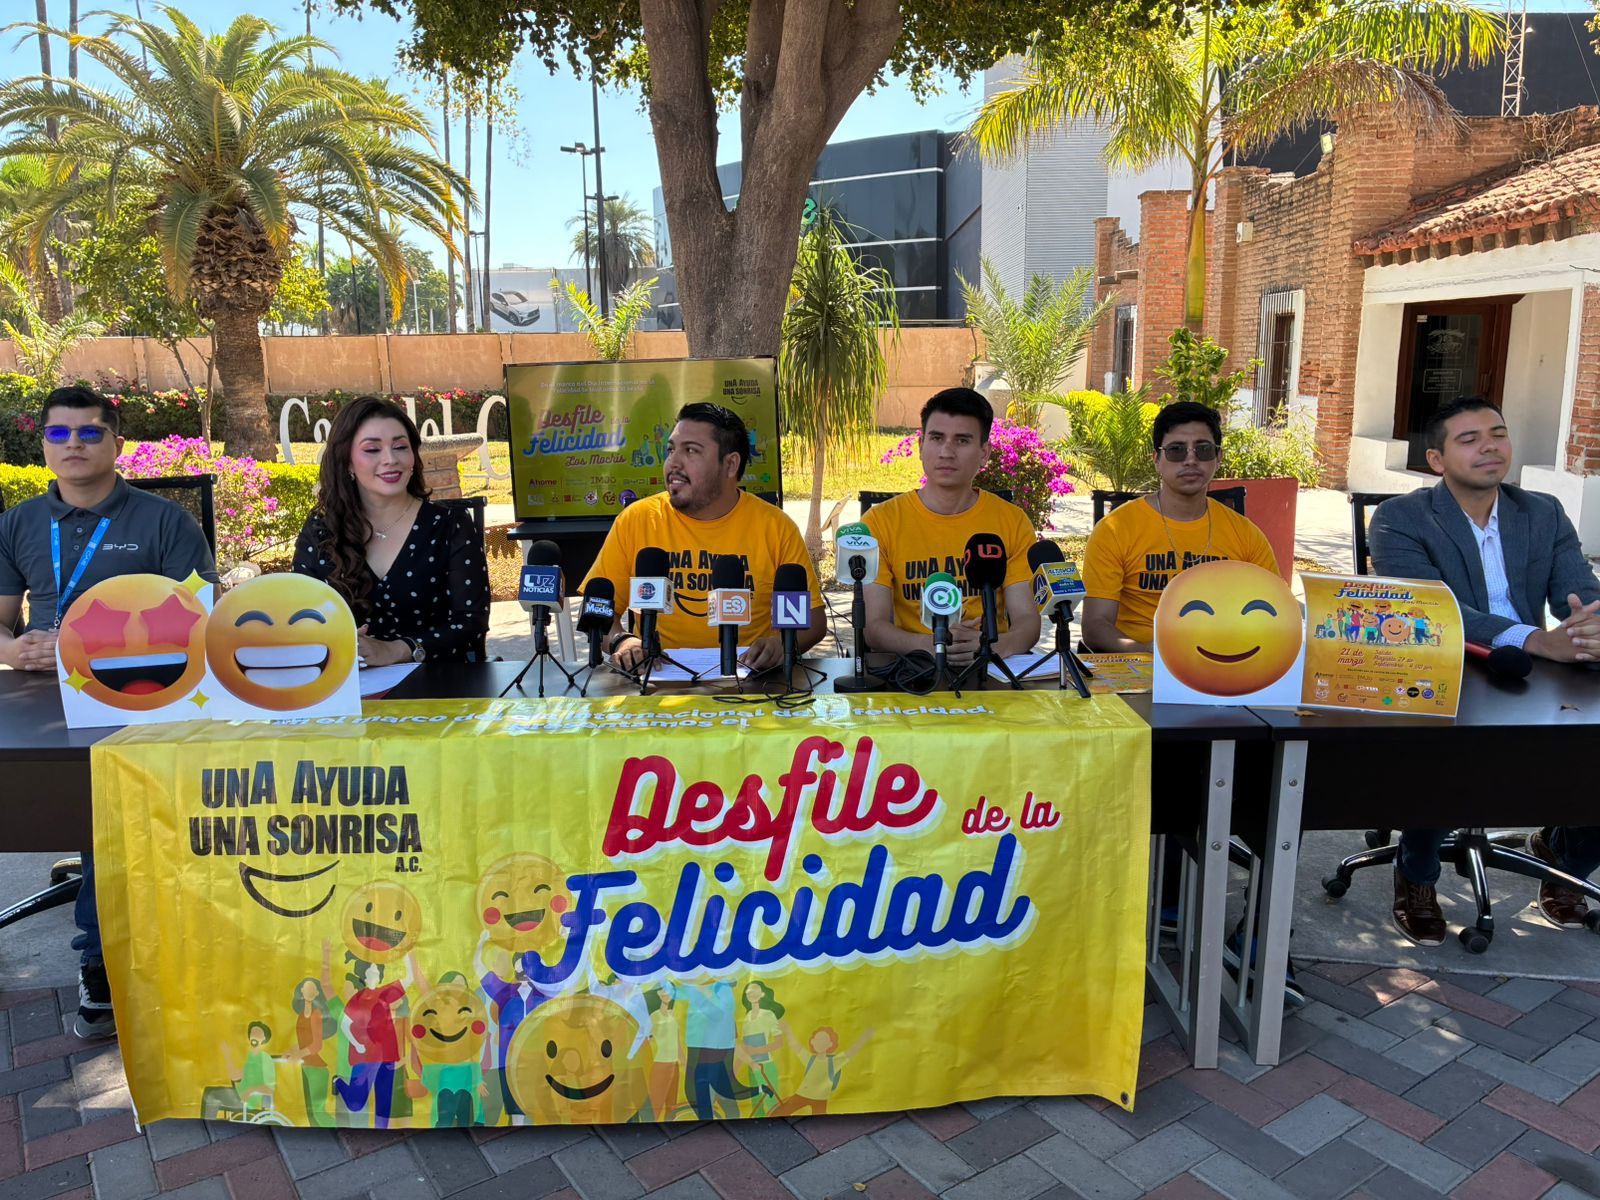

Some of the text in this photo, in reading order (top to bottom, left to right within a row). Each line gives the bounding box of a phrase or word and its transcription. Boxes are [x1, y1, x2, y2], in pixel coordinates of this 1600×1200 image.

[522, 424, 627, 456] Felicidad
[565, 453, 626, 467] Los Mochis
[102, 543, 139, 551] BYD
[905, 557, 939, 580] UNA
[1145, 551, 1176, 571] UNA
[524, 574, 555, 588] LUZ
[1138, 573, 1168, 590] UNA
[902, 583, 925, 600] UN
[1334, 588, 1414, 600] Felicidad
[1340, 648, 1350, 656] 21
[1337, 657, 1365, 666] marzo
[351, 714, 449, 725] marco
[201, 760, 410, 809] UNA AYUDA
[602, 735, 1062, 882] Desfile de la
[189, 813, 423, 857] UNA SONRISA
[394, 856, 423, 873] A.C.
[521, 832, 1032, 985] Felicidad
